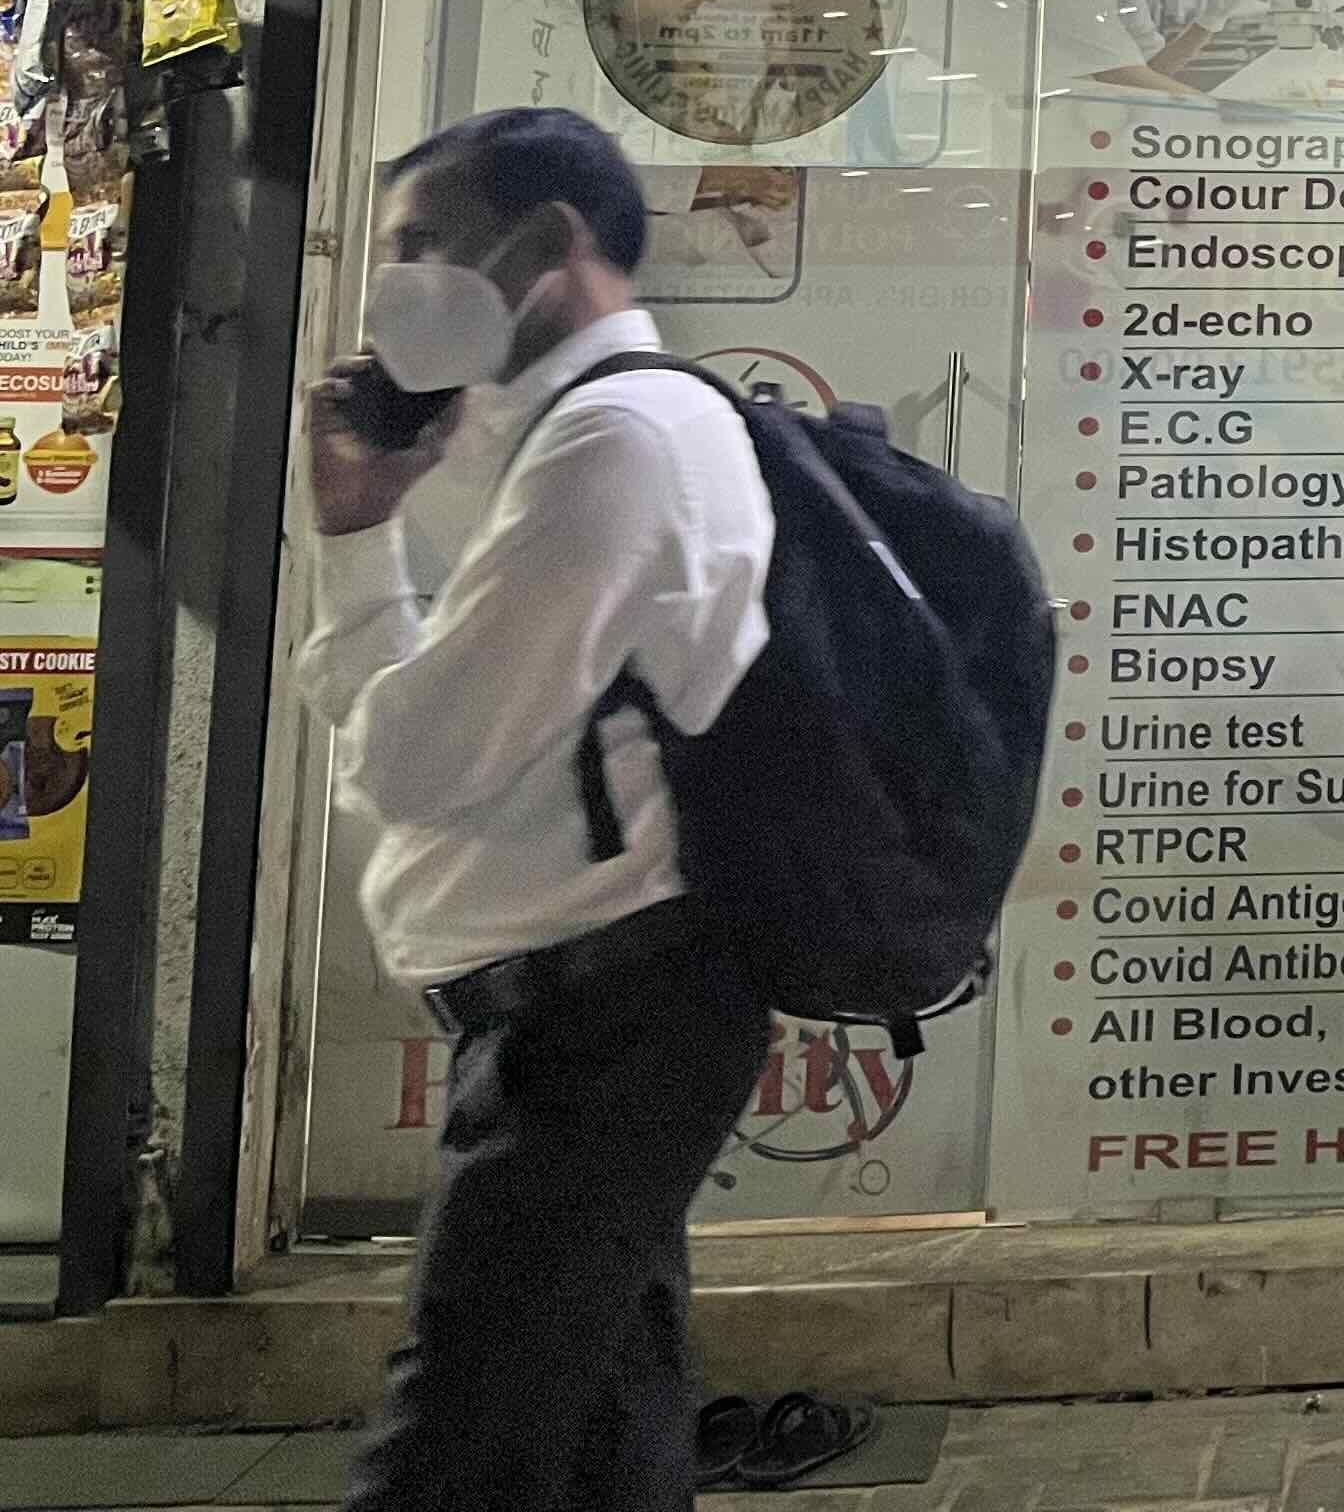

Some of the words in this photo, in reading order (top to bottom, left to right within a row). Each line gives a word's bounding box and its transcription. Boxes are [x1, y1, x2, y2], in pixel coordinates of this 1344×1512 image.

[1129, 177, 1289, 212] Colour
[1123, 304, 1313, 338] 2d-echo
[1121, 357, 1245, 399] X-ray
[1120, 410, 1254, 446] E.C.G
[1112, 593, 1249, 629] FNAC
[33, 653, 95, 670] COOKIE
[1109, 647, 1276, 690] Biopsy
[1100, 714, 1211, 752] Urine
[1226, 714, 1303, 749] test
[1098, 770, 1212, 808] Urine
[1225, 770, 1282, 806] for
[1096, 827, 1248, 864] RTPCR
[1092, 887, 1215, 924] Covid
[1089, 947, 1212, 984] Covid
[1090, 1008, 1154, 1043] All
[1172, 1006, 1328, 1043] Blood,
[1088, 1064, 1216, 1102] other
[1088, 1129, 1279, 1172] FREE
